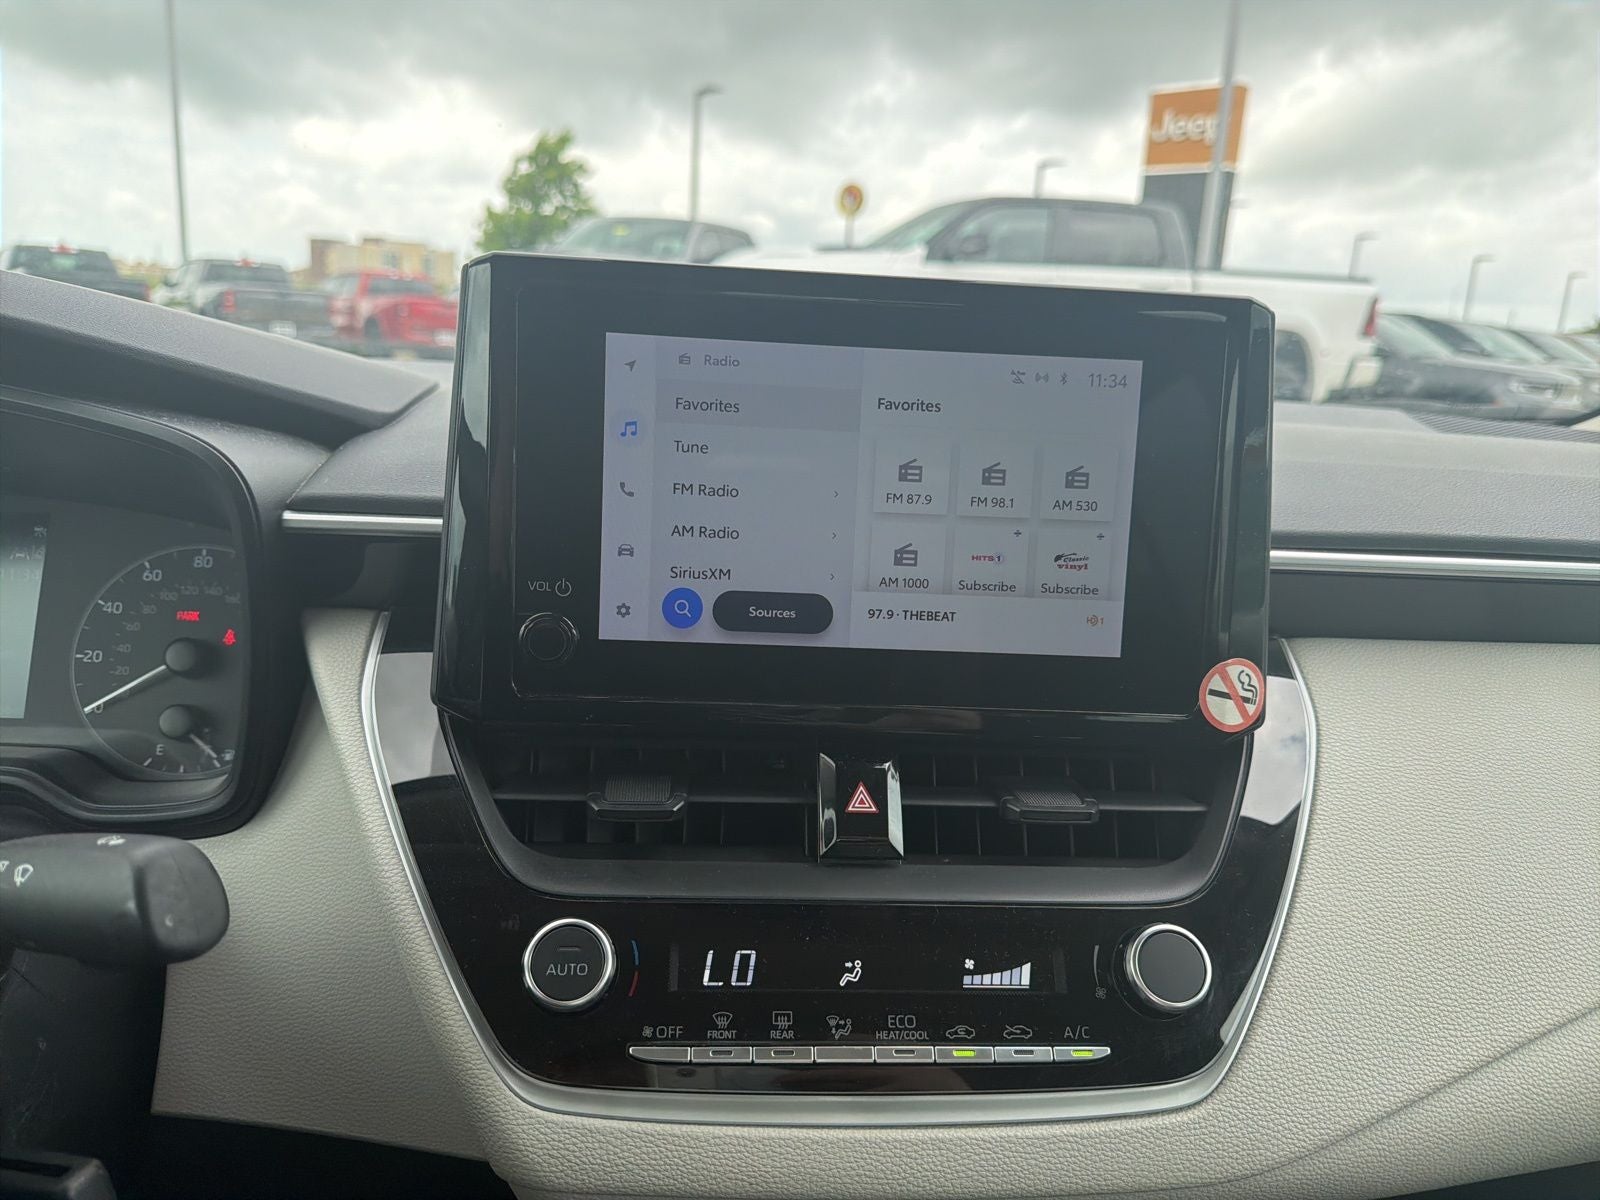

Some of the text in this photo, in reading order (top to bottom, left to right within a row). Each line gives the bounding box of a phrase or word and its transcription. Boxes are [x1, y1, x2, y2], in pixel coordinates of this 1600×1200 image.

[704, 354, 740, 368] Radio
[1088, 373, 1128, 389] 11:34
[675, 397, 740, 413] Favorites
[877, 397, 941, 413] Favorites
[674, 440, 709, 455] Tune
[673, 482, 739, 498] FM Radio
[886, 492, 932, 505] FM 87.9
[970, 496, 1014, 509] FM 98.1
[1052, 499, 1098, 512] AM 530
[671, 524, 740, 540] AM Radio
[194, 556, 213, 568] 80
[1063, 555, 1089, 563] Classic
[670, 566, 731, 581] SiriusXM
[1056, 563, 1089, 572] vinyl
[143, 569, 162, 582] 60
[528, 580, 551, 591] VOL
[879, 577, 929, 589] AM 1000
[958, 580, 1016, 593] Subscribe
[1040, 583, 1099, 596] Subscribe
[103, 602, 123, 615] 40
[749, 606, 796, 619] Sources
[868, 608, 957, 622] 97.9 THEBEAT
[84, 650, 103, 663] 20
[156, 744, 164, 756] E
[546, 963, 588, 976] AUTO
[703, 950, 757, 986] LO
[888, 1015, 916, 1029] ECO
[656, 1026, 683, 1039] OFF
[707, 1030, 738, 1039] FRONT
[770, 1030, 795, 1039] REAR
[876, 1030, 930, 1041] HEAT/COOL
[1064, 1026, 1090, 1040] A/C
